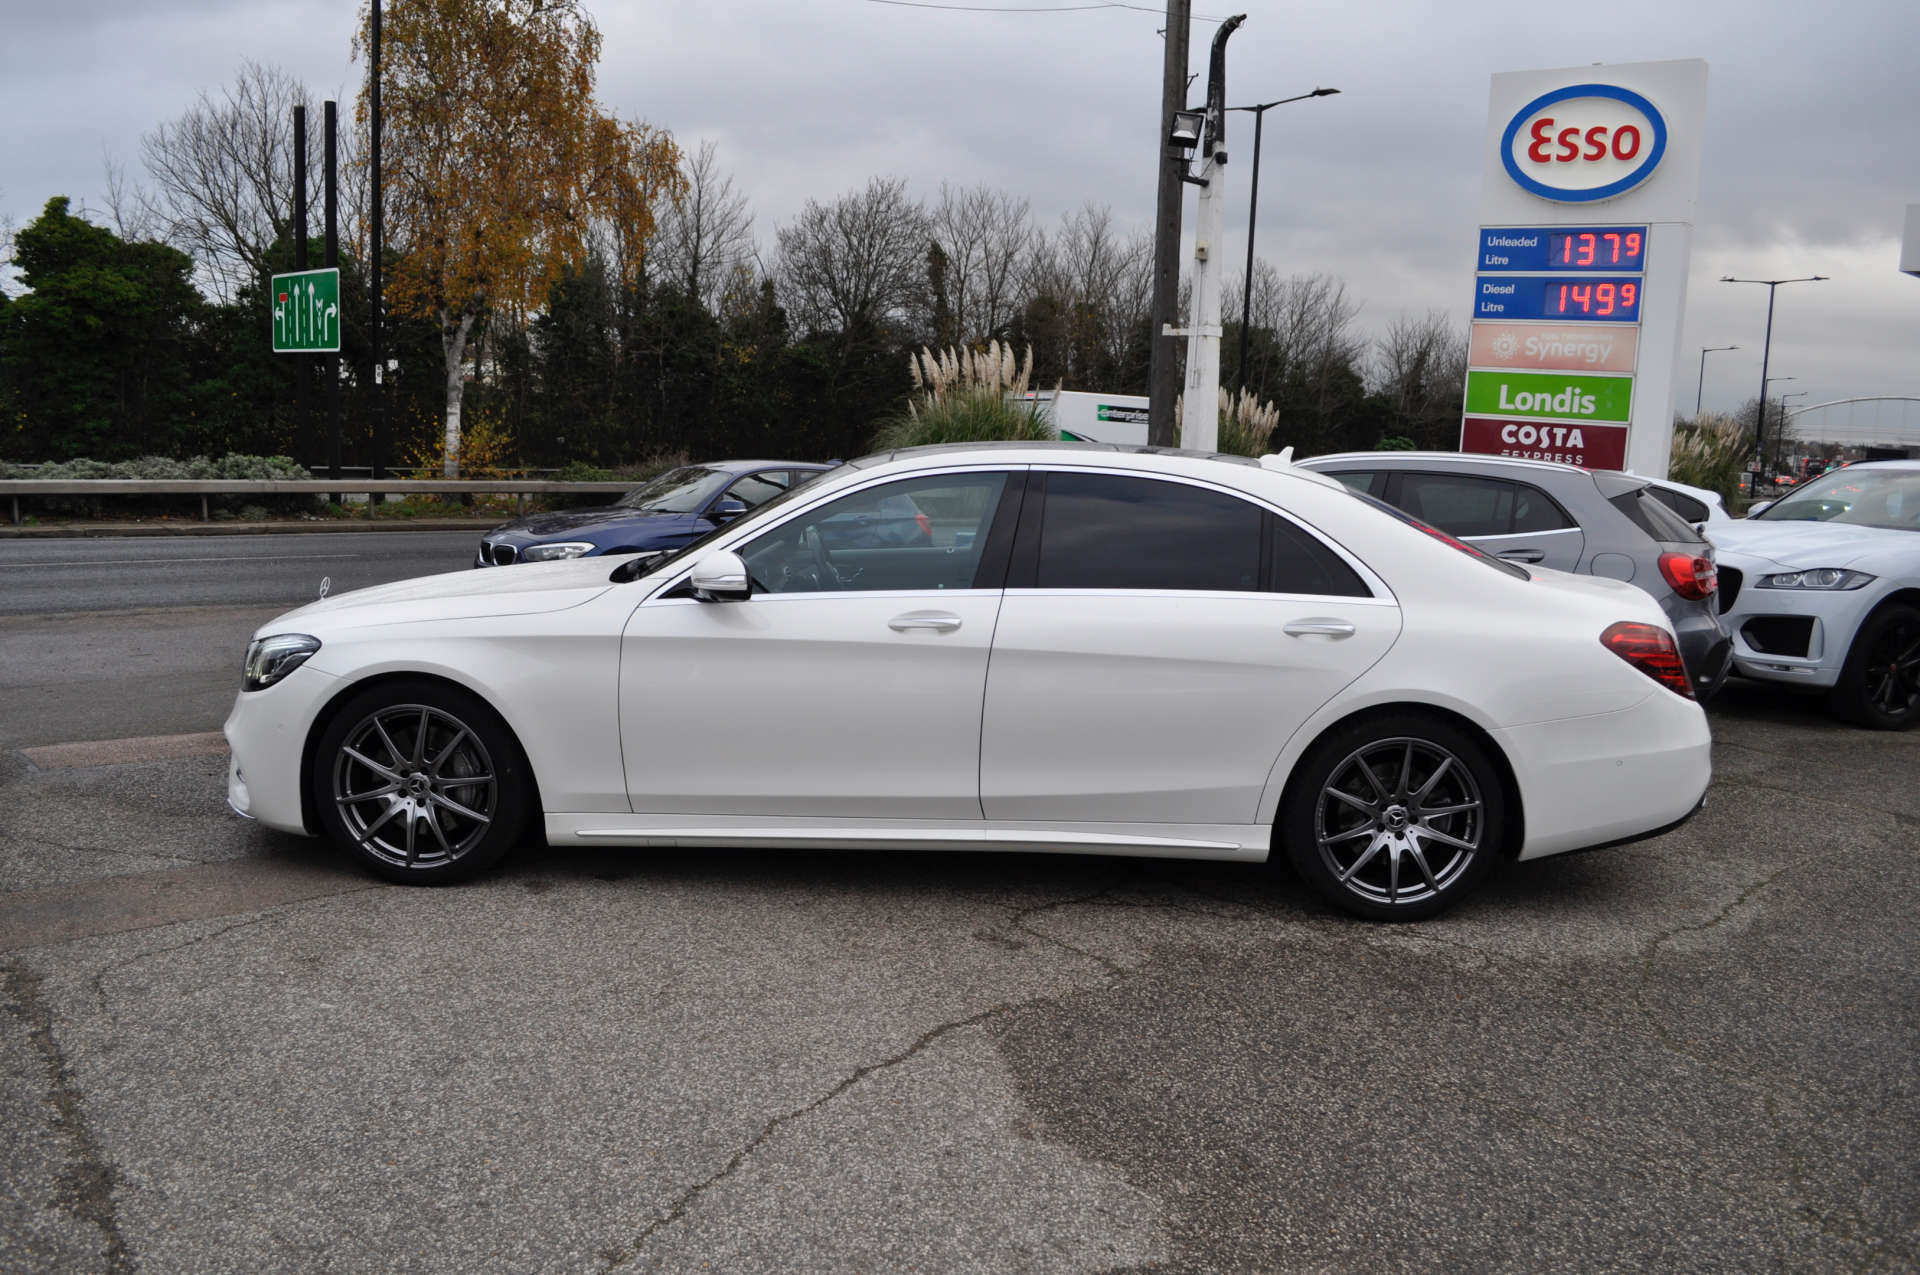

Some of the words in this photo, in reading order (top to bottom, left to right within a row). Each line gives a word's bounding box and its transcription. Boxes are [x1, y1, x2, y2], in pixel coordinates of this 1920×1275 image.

[1528, 118, 1640, 163] Esso
[1487, 236, 1538, 247] Unleaded
[1485, 254, 1509, 265] Litre
[1482, 283, 1516, 294] Diesel
[1481, 302, 1505, 313] Litre
[1525, 336, 1613, 363] Synergy
[1499, 384, 1596, 414] Londis
[1501, 424, 1584, 449] COSTA
